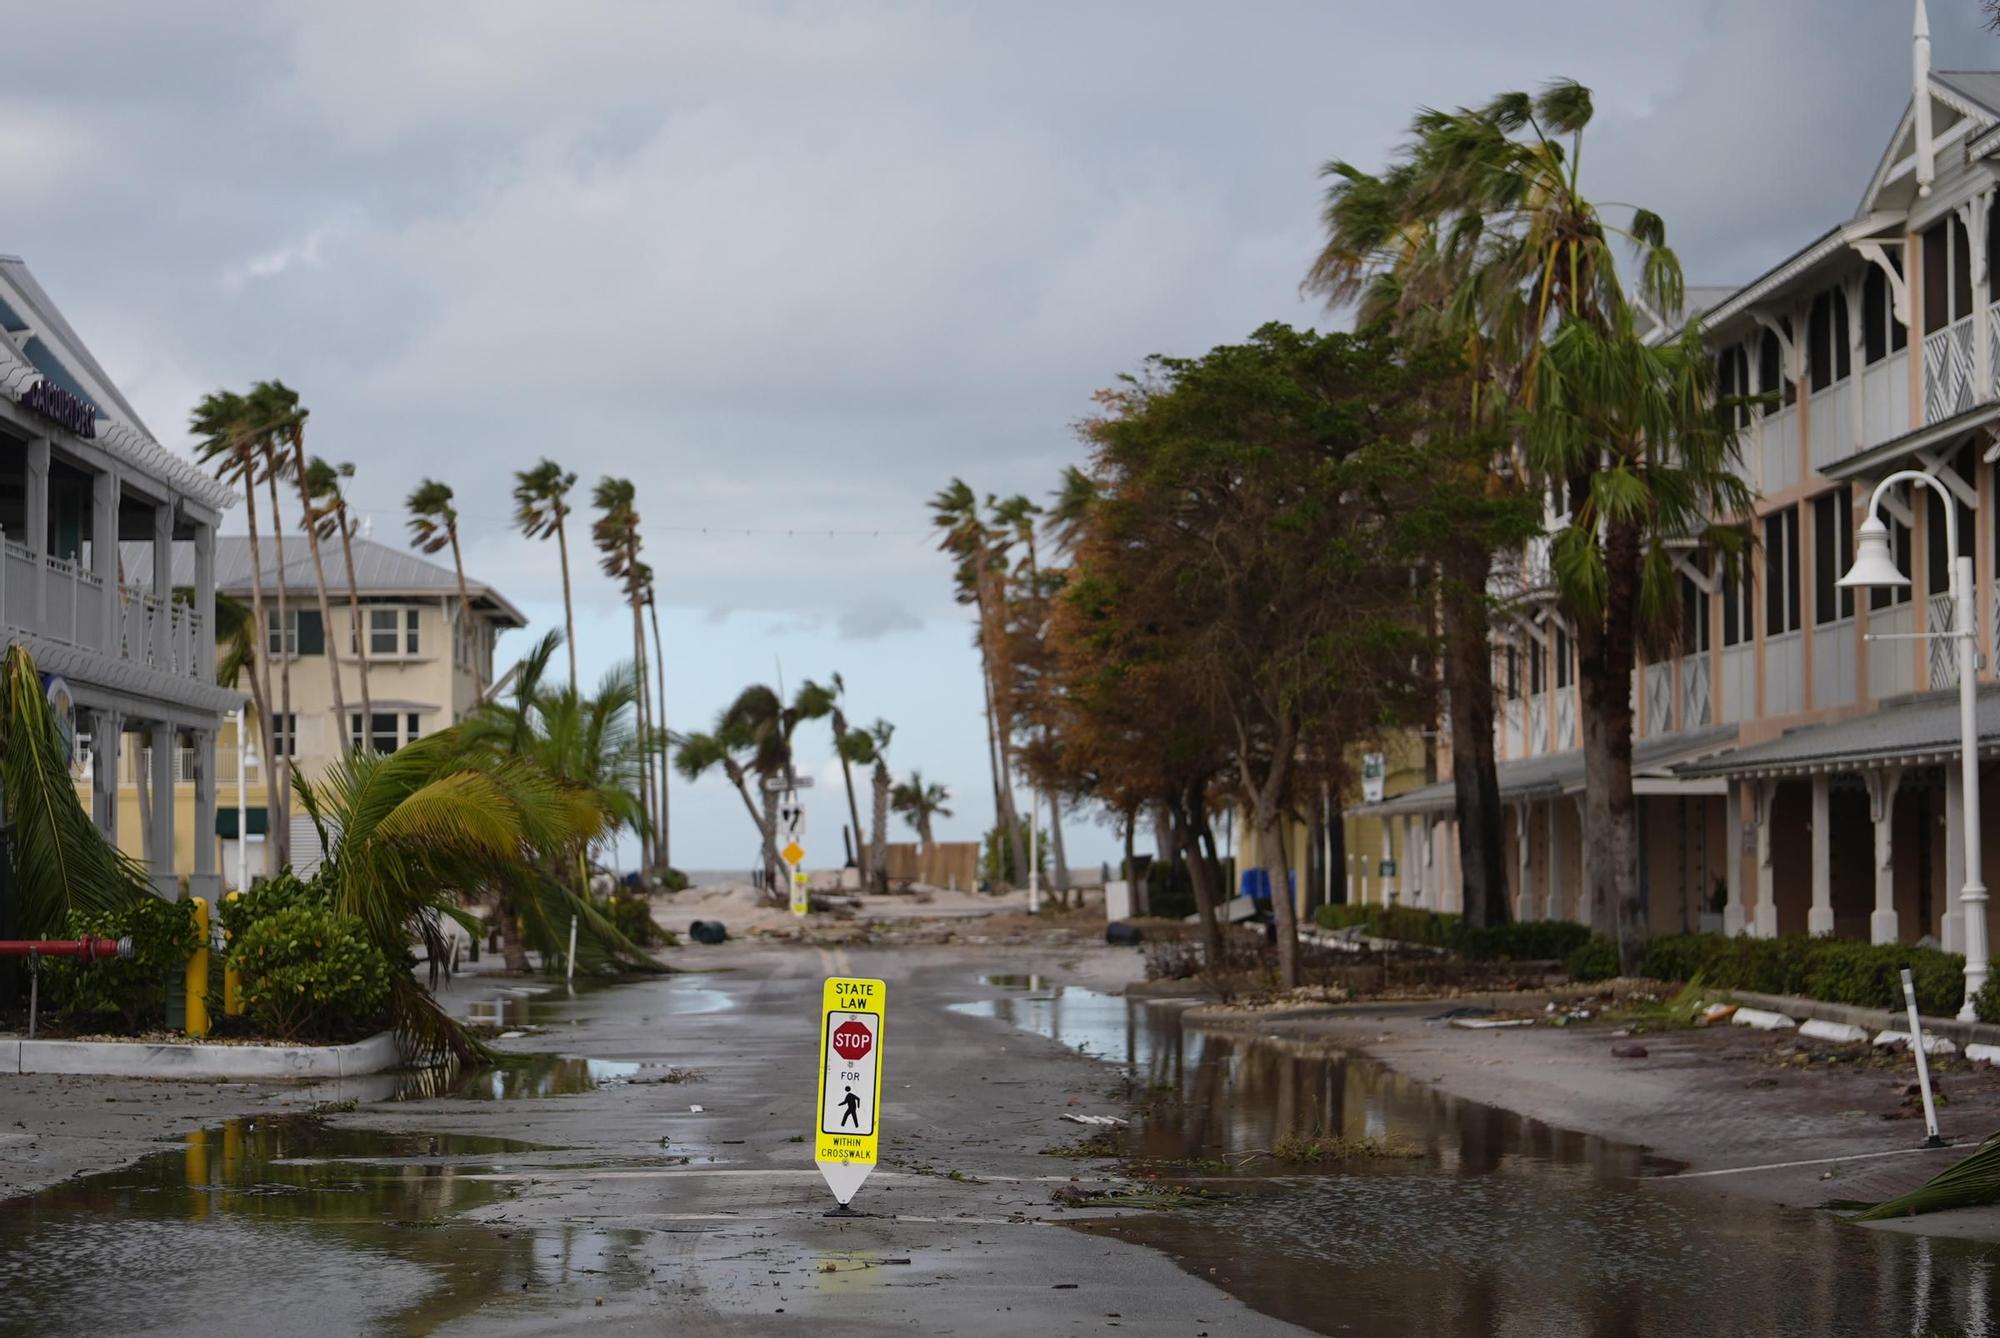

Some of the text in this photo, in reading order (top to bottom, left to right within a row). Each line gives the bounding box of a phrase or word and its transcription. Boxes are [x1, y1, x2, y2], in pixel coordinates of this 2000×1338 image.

[836, 983, 874, 996] STATE
[841, 998, 867, 1009] LAW
[835, 1033, 870, 1048] STOP
[841, 1072, 860, 1081] FOR
[833, 1138, 861, 1147] WITHIN
[821, 1148, 871, 1159] CROSSWALK
